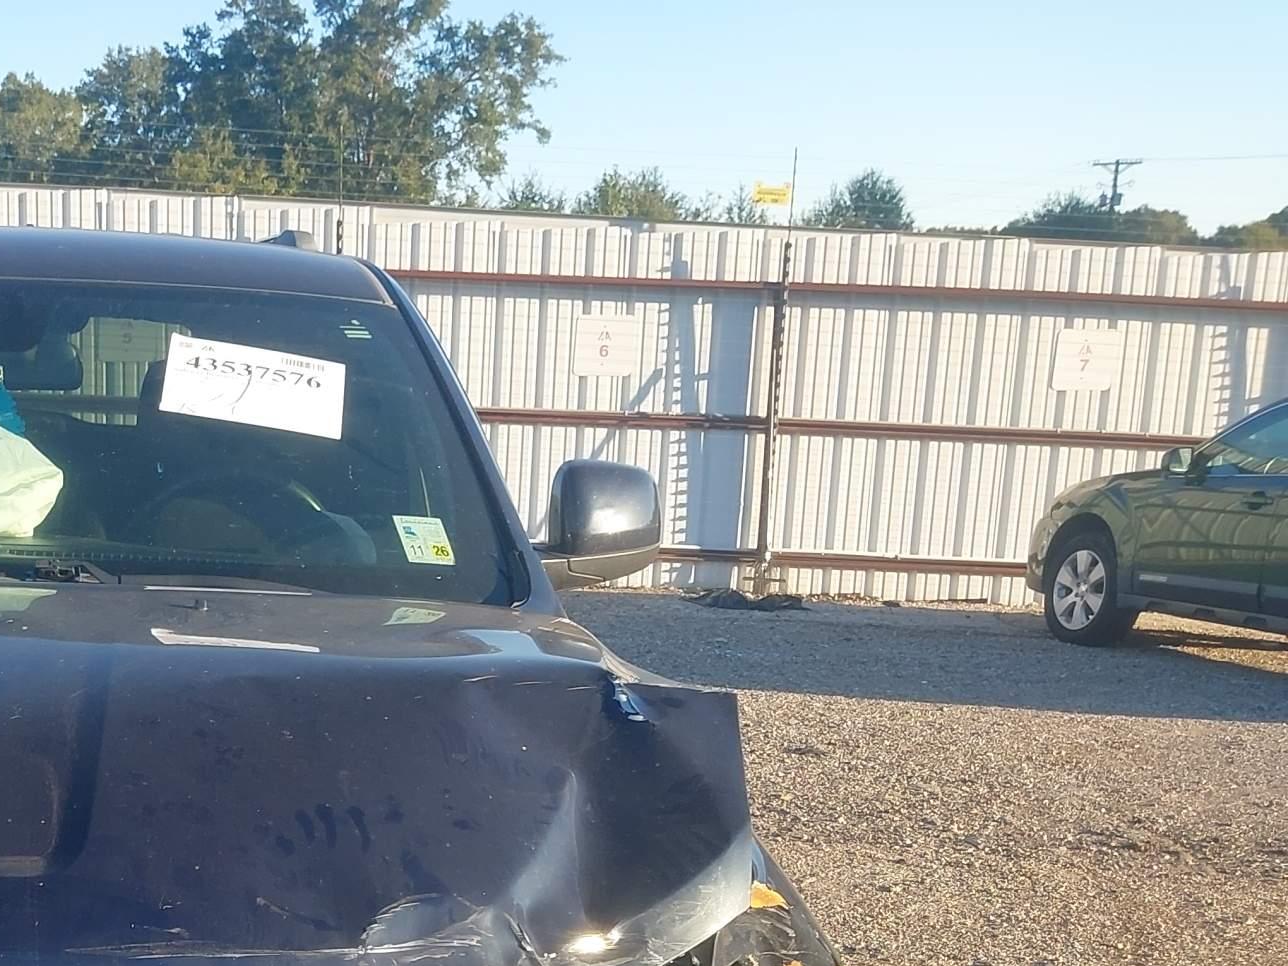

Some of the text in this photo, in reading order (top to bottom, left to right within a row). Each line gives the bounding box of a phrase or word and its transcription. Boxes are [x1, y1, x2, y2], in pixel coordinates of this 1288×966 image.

[600, 345, 609, 357] 6
[1080, 359, 1090, 371] 7
[186, 355, 322, 389] 43537576
[410, 544, 424, 556] 11
[433, 545, 449, 557] 26
